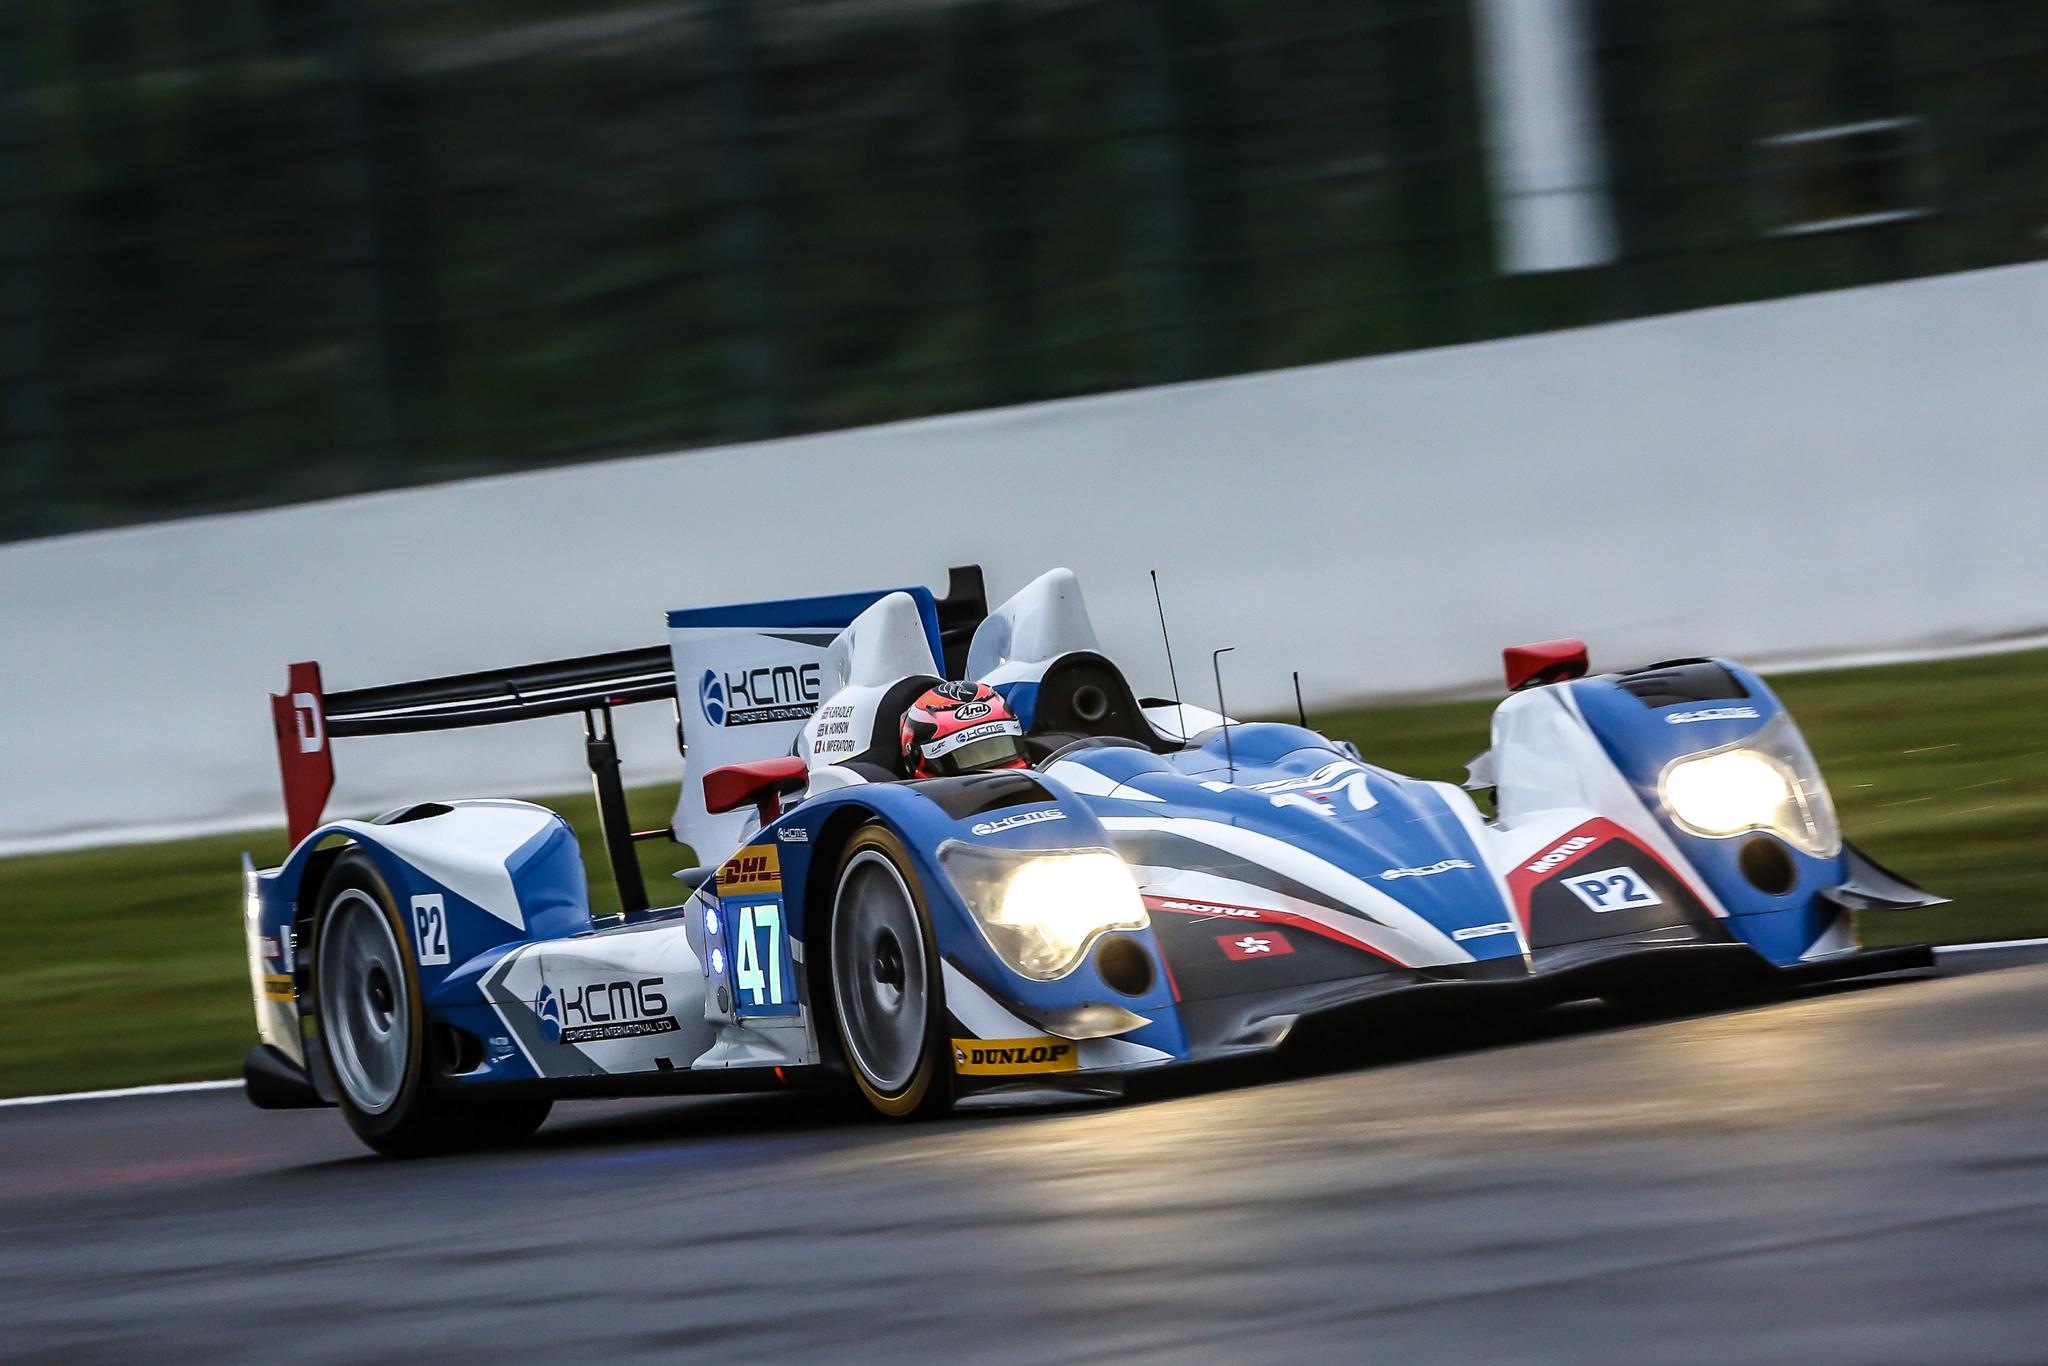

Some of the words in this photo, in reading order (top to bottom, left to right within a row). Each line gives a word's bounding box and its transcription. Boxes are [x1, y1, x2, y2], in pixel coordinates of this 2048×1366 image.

[724, 857, 771, 884] DHL
[1525, 836, 1598, 873] MOTUL
[1576, 874, 1650, 906] P2
[1160, 901, 1261, 918] MOTUL
[416, 906, 446, 956] P2
[737, 905, 782, 1005] 47
[560, 977, 668, 1025] KCMG
[565, 1027, 604, 1041] COMPOSITES
[604, 1021, 656, 1037] INTERNATIONAL
[656, 1020, 672, 1031] LTD
[971, 1045, 1071, 1065] DUNLOP
